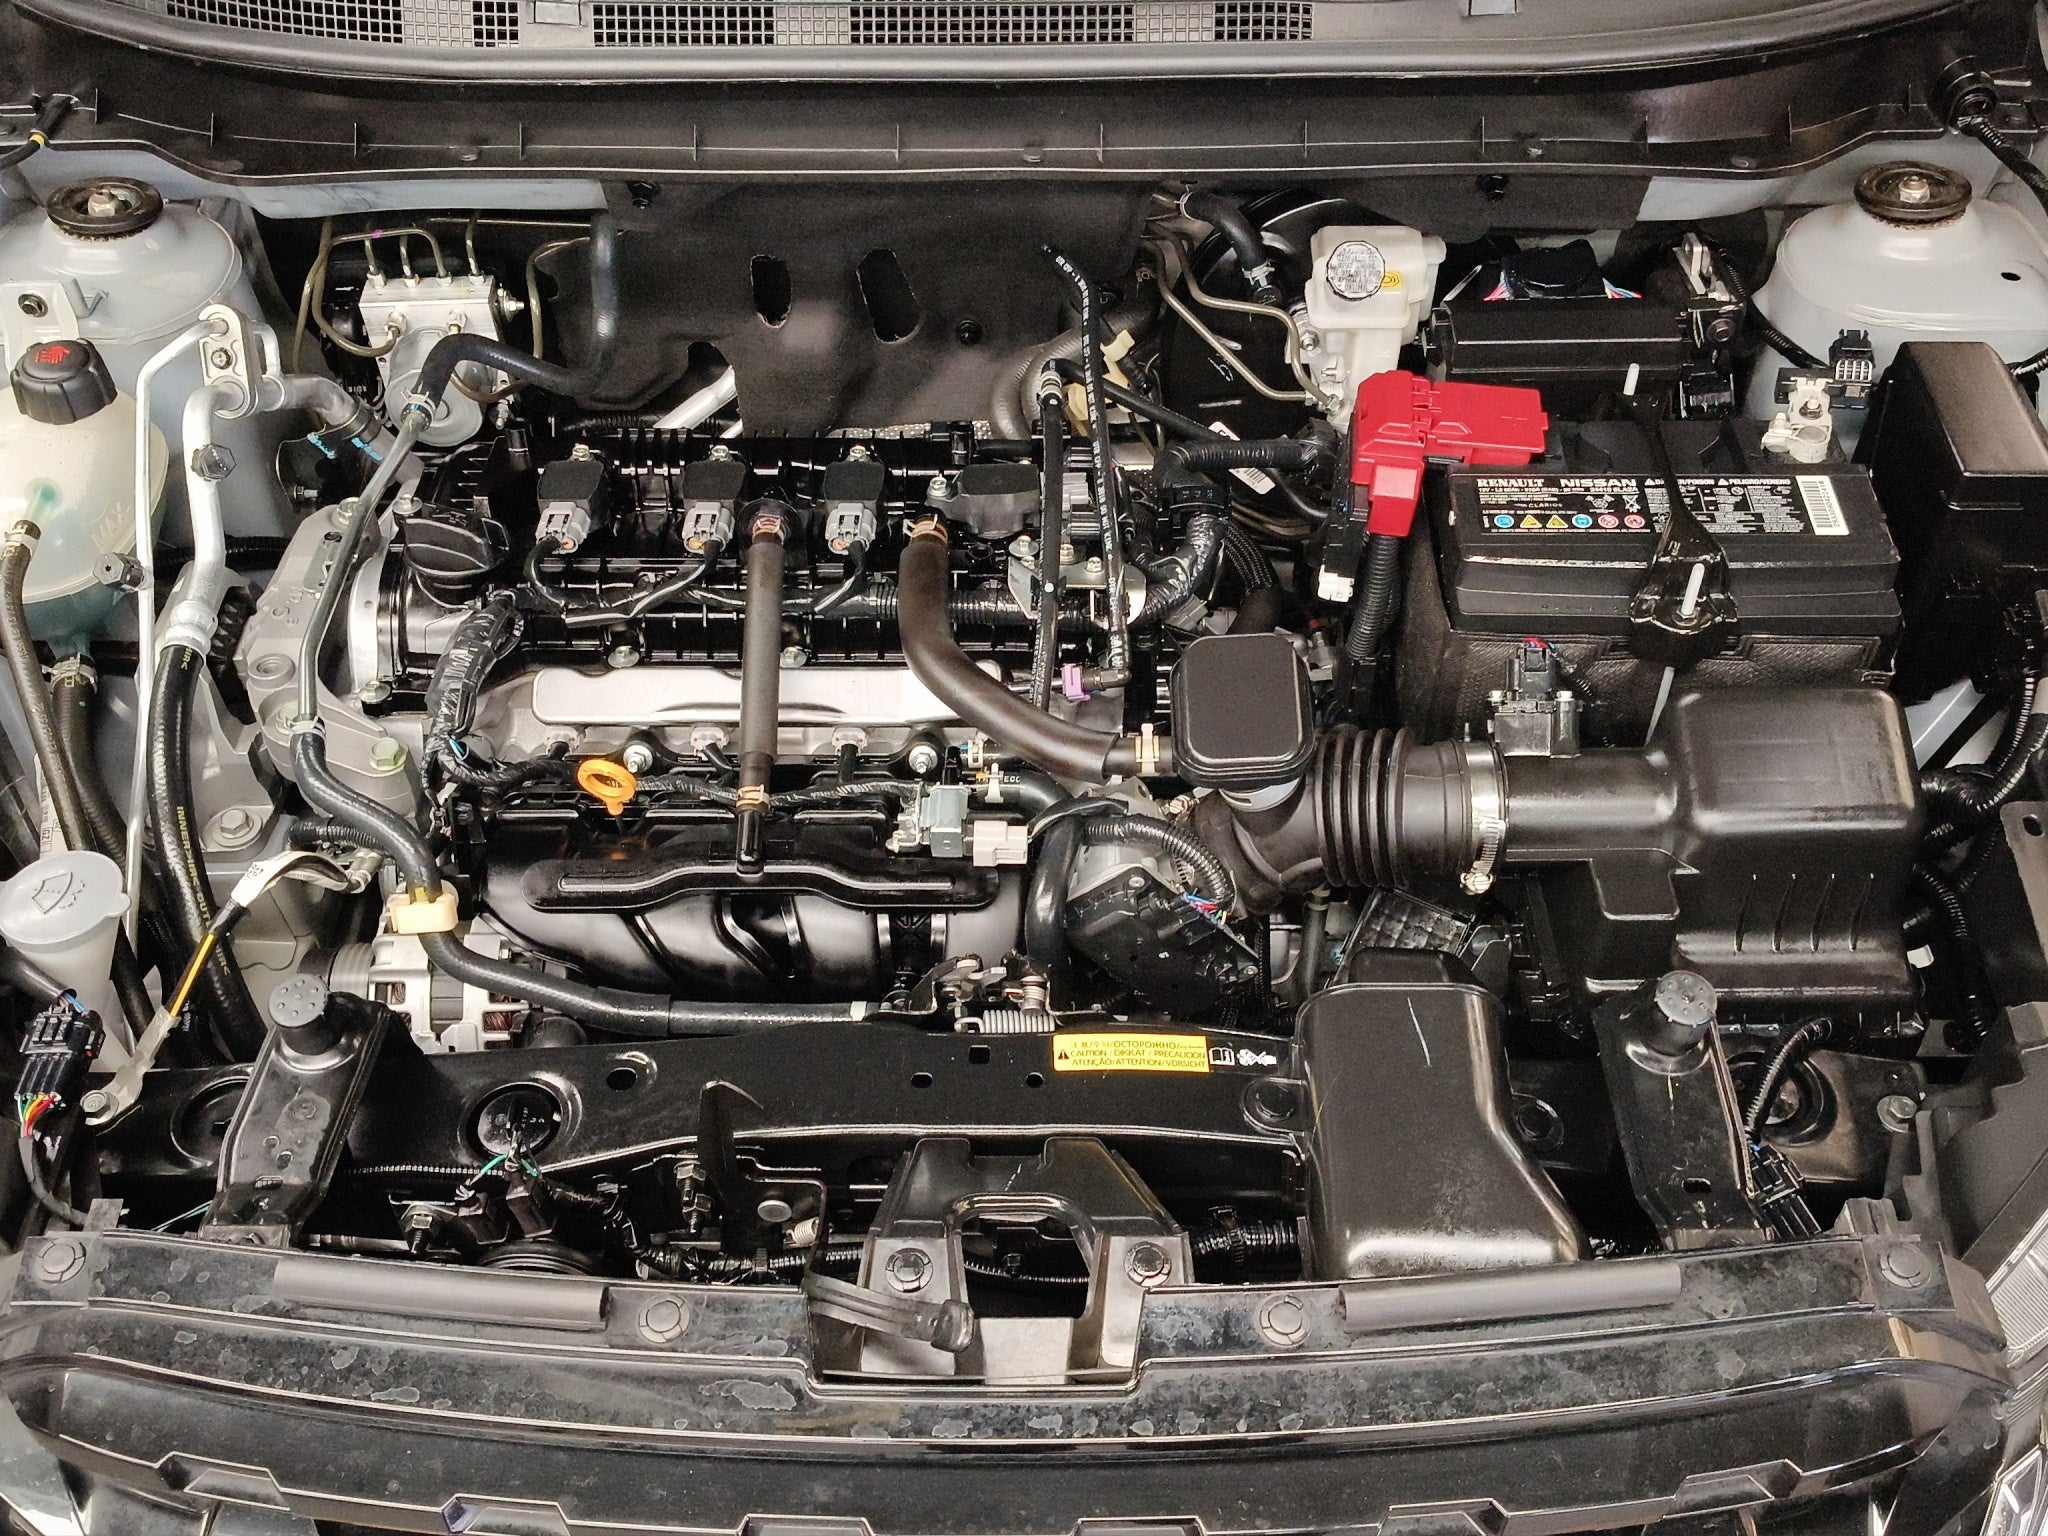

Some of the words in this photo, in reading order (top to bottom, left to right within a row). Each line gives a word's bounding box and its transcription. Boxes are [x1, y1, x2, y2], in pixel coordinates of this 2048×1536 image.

[1476, 478, 1545, 488] RENAULT
[1559, 478, 1637, 488] NISSAN
[1070, 1049, 1107, 1057] CAUTION
